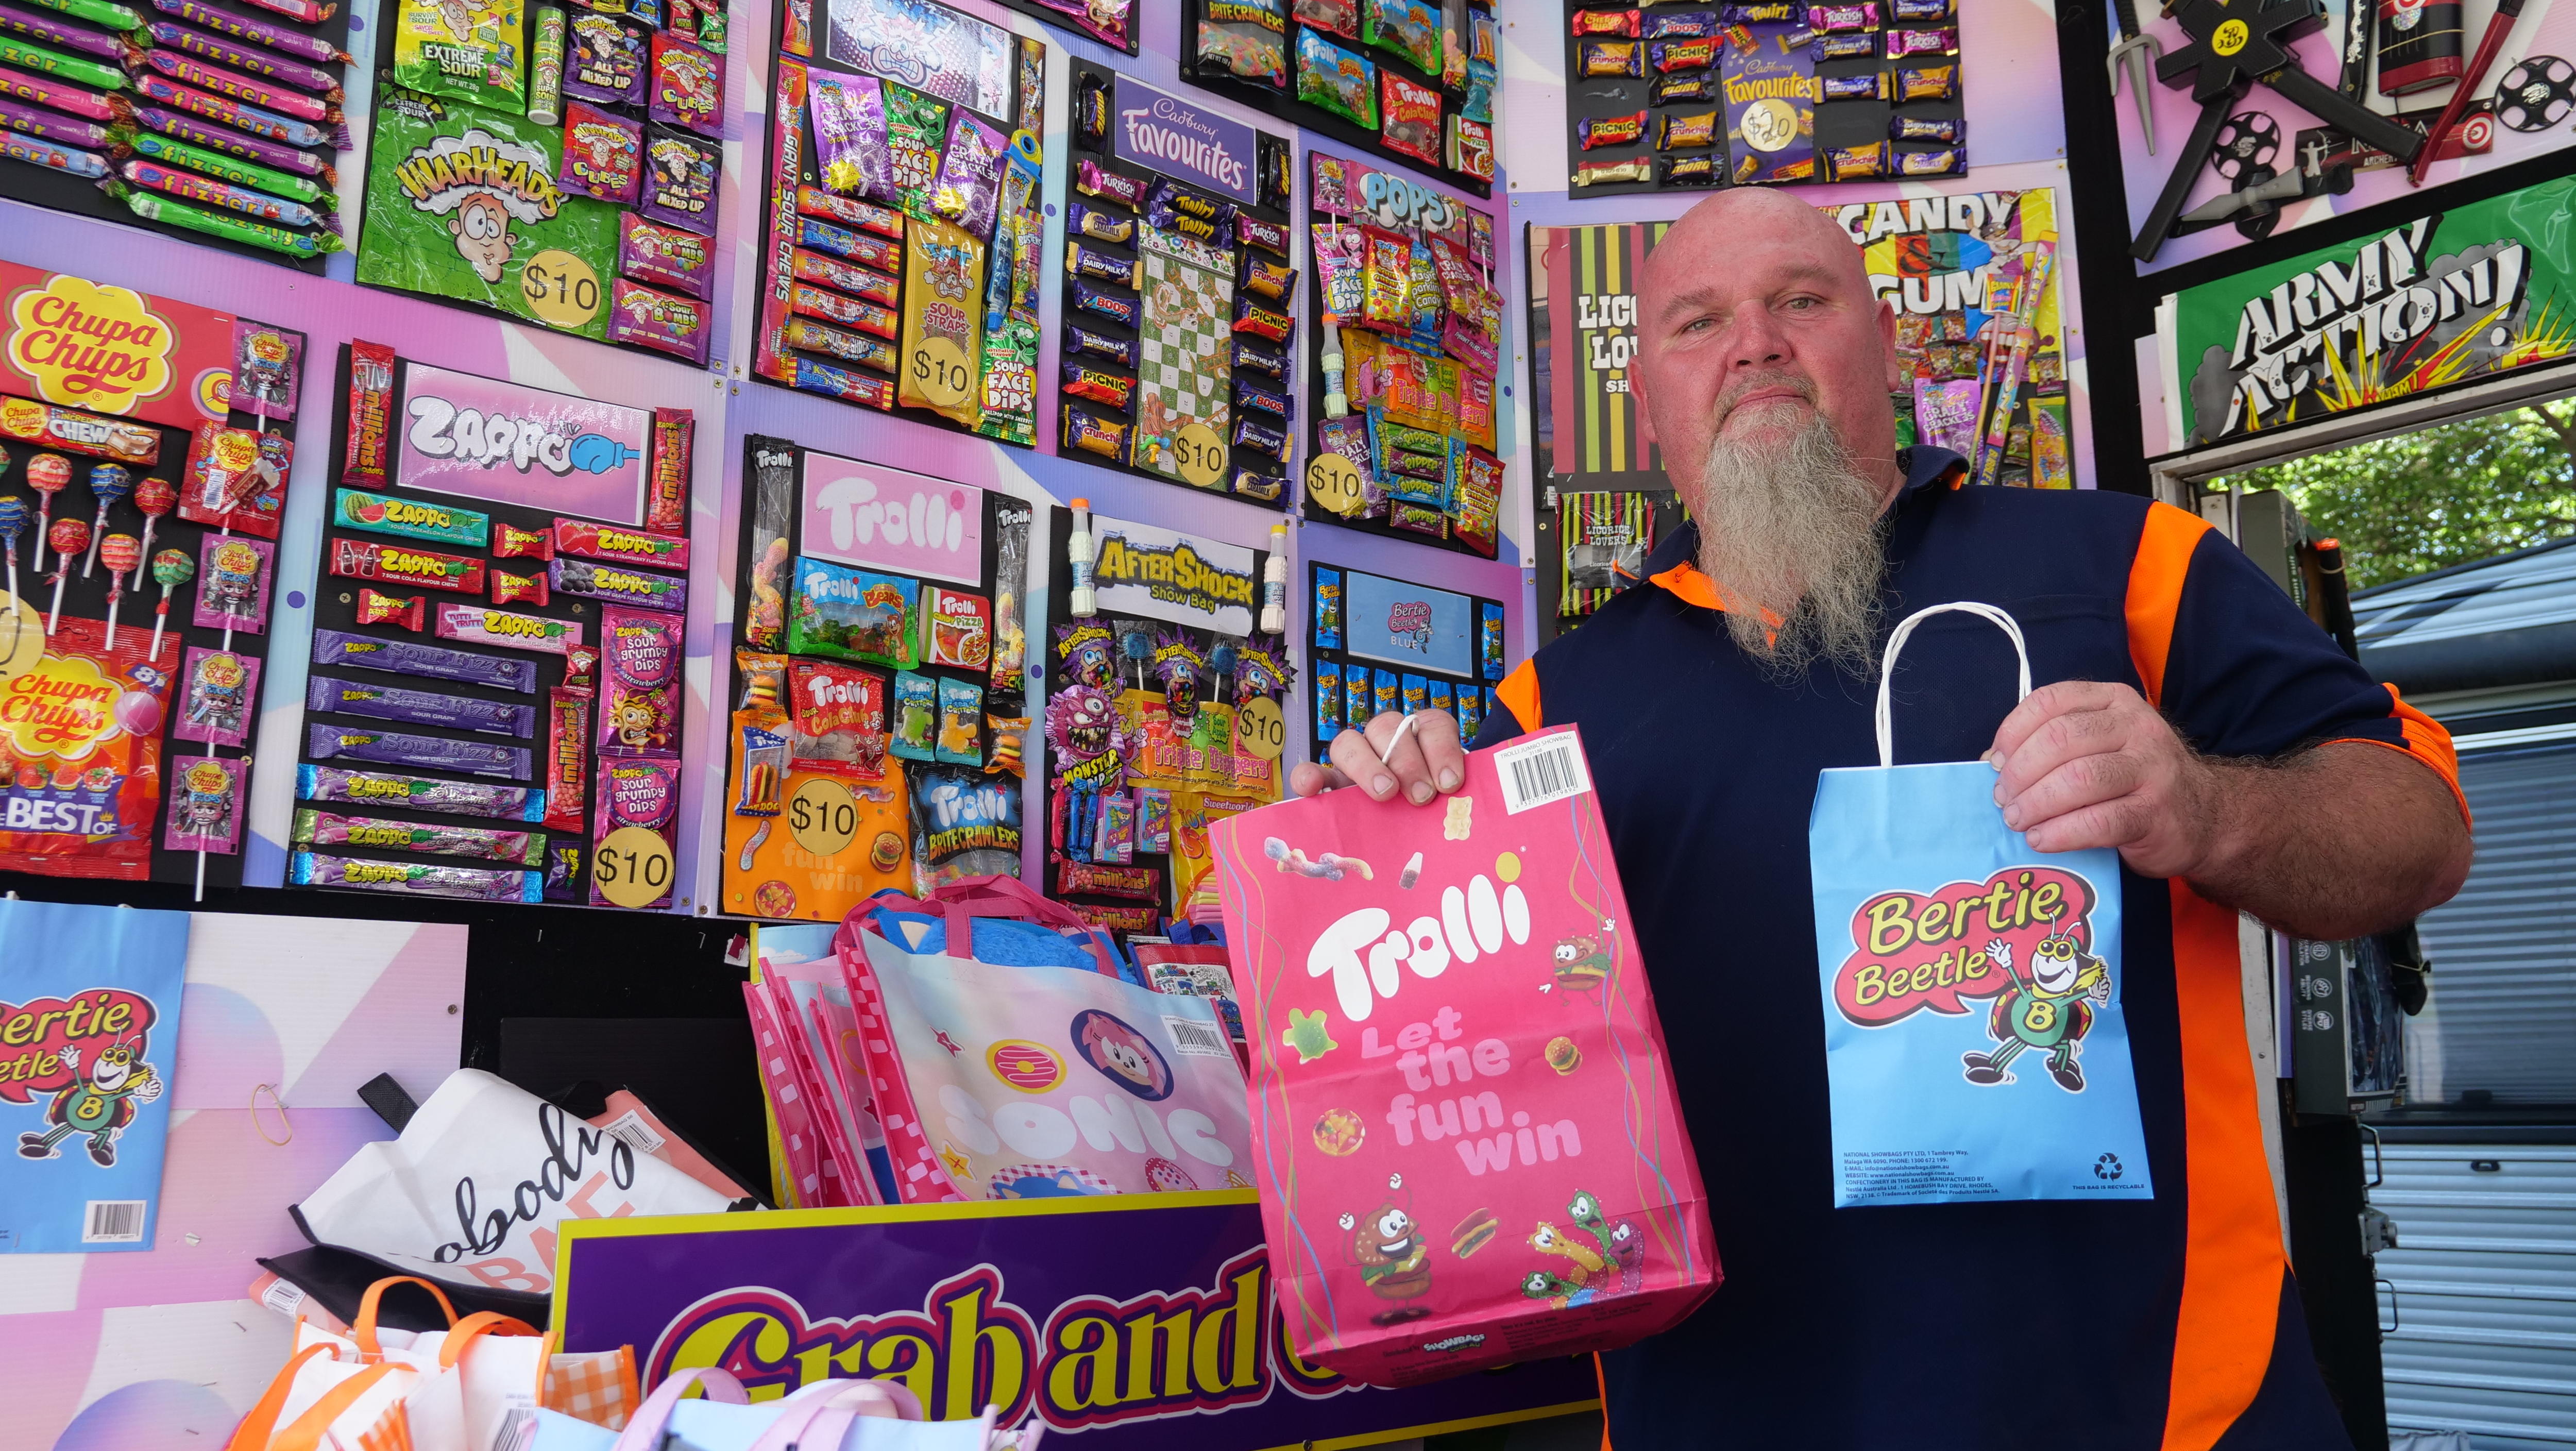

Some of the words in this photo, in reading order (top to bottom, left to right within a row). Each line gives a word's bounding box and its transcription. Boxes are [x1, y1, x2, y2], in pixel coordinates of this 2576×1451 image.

[1233, 5, 1285, 33] CRAWLERS
[181, 32, 274, 75] fizzer
[424, 47, 485, 67] EXTREME
[440, 60, 481, 77] SOUR
[593, 60, 615, 75] ALL
[1667, 45, 1709, 60] PICNIC
[1745, 59, 1793, 76] Cadbury
[177, 63, 270, 105] fizzer
[614, 77, 631, 88] UP
[1723, 75, 1814, 103] Favourites
[1154, 98, 1218, 141] Cadbury
[1592, 121, 1636, 134] PICNIC
[1748, 112, 1790, 140] $20
[165, 118, 260, 159] fizzer
[1122, 108, 1243, 190] Favourites
[163, 145, 258, 186] fizzer
[785, 133, 798, 185] GIANT
[2363, 154, 2397, 166] ARCHER
[395, 146, 565, 211] WARHEADS
[1102, 173, 1136, 194] TURKISH
[778, 188, 795, 238] SOUR
[1176, 196, 1215, 218] Twirl
[1366, 174, 1447, 224] POPS
[1093, 222, 1120, 237] CARAMILK
[1176, 215, 1214, 239] Twirl
[1836, 193, 2019, 245] CANDY
[774, 244, 795, 303] CHEWS
[1083, 259, 1104, 270] DAIRY
[1104, 263, 1121, 274] MILK
[524, 262, 598, 310] $10
[1868, 265, 1988, 315] GUM
[2229, 215, 2431, 370] ARMY
[32, 296, 159, 347] Chupa
[926, 313, 968, 333] STRAPS
[928, 302, 965, 318] SOUR
[1250, 308, 1287, 329] PICNIC
[2219, 244, 2522, 437] ACTION!
[21, 329, 151, 394] Chups
[913, 349, 968, 392] $10
[993, 361, 1025, 373] SOUR
[985, 372, 1031, 392] FACE
[1606, 379, 1630, 393] SH
[49, 417, 113, 443] CHEW
[61, 413, 109, 427] INCREDIBLE
[361, 391, 381, 467] millions
[662, 429, 681, 499] millions
[1176, 435, 1222, 471] $10
[1310, 463, 1360, 497] $10
[385, 501, 452, 526] ZAPPO
[816, 476, 965, 552] Trolli
[1585, 525, 1630, 536] LICORICE
[1589, 535, 1628, 546] LOVERS
[805, 572, 859, 600] Trolli
[1151, 584, 1187, 604] Show
[1191, 594, 1216, 614] Bag
[1391, 619, 1414, 628] Beetle
[1394, 603, 1427, 616] Bertie
[388, 642, 442, 663] Sour
[620, 647, 669, 661] grumpy
[1391, 635, 1418, 650] BLUE
[414, 663, 433, 671] SOUR
[434, 665, 459, 674] GRAPE
[9, 673, 113, 704] Chupa
[808, 675, 870, 706] Trolli
[2, 695, 106, 745] Chups
[1239, 707, 1284, 746] $10
[1151, 738, 1204, 769] Triple
[1208, 747, 1268, 779] Dippers
[1501, 750, 1520, 759] TROLLI
[1521, 743, 1540, 754] JUMBO
[1541, 734, 1571, 746] SHOWBAG
[1062, 750, 1119, 785] MONSTER
[931, 785, 1006, 827] Trolli
[1204, 798, 1255, 811] Sweetworld
[1552, 786, 1576, 797] 019892
[6, 797, 101, 836] BEST
[92, 821, 117, 836] OF
[791, 795, 855, 834] $10
[596, 846, 666, 887] $10
[1093, 873, 1144, 889] millions
[1867, 871, 2066, 956] Bertie
[1307, 850, 1531, 1022] Trolli
[1852, 950, 1991, 1007] Beetle
[0, 993, 133, 1046] ertie
[1361, 1005, 1464, 1059] Let
[0, 1050, 59, 1083] etle
[1395, 1035, 1511, 1092] the
[938, 1083, 1234, 1168] SONIC
[1386, 1090, 1504, 1146] fun
[1455, 1110, 1582, 1176] win
[434, 1102, 635, 1264] obody
[658, 1285, 1026, 1423] Grab
[1047, 1263, 1270, 1414] and
[1423, 1333, 1486, 1353] SHOWBAGS
